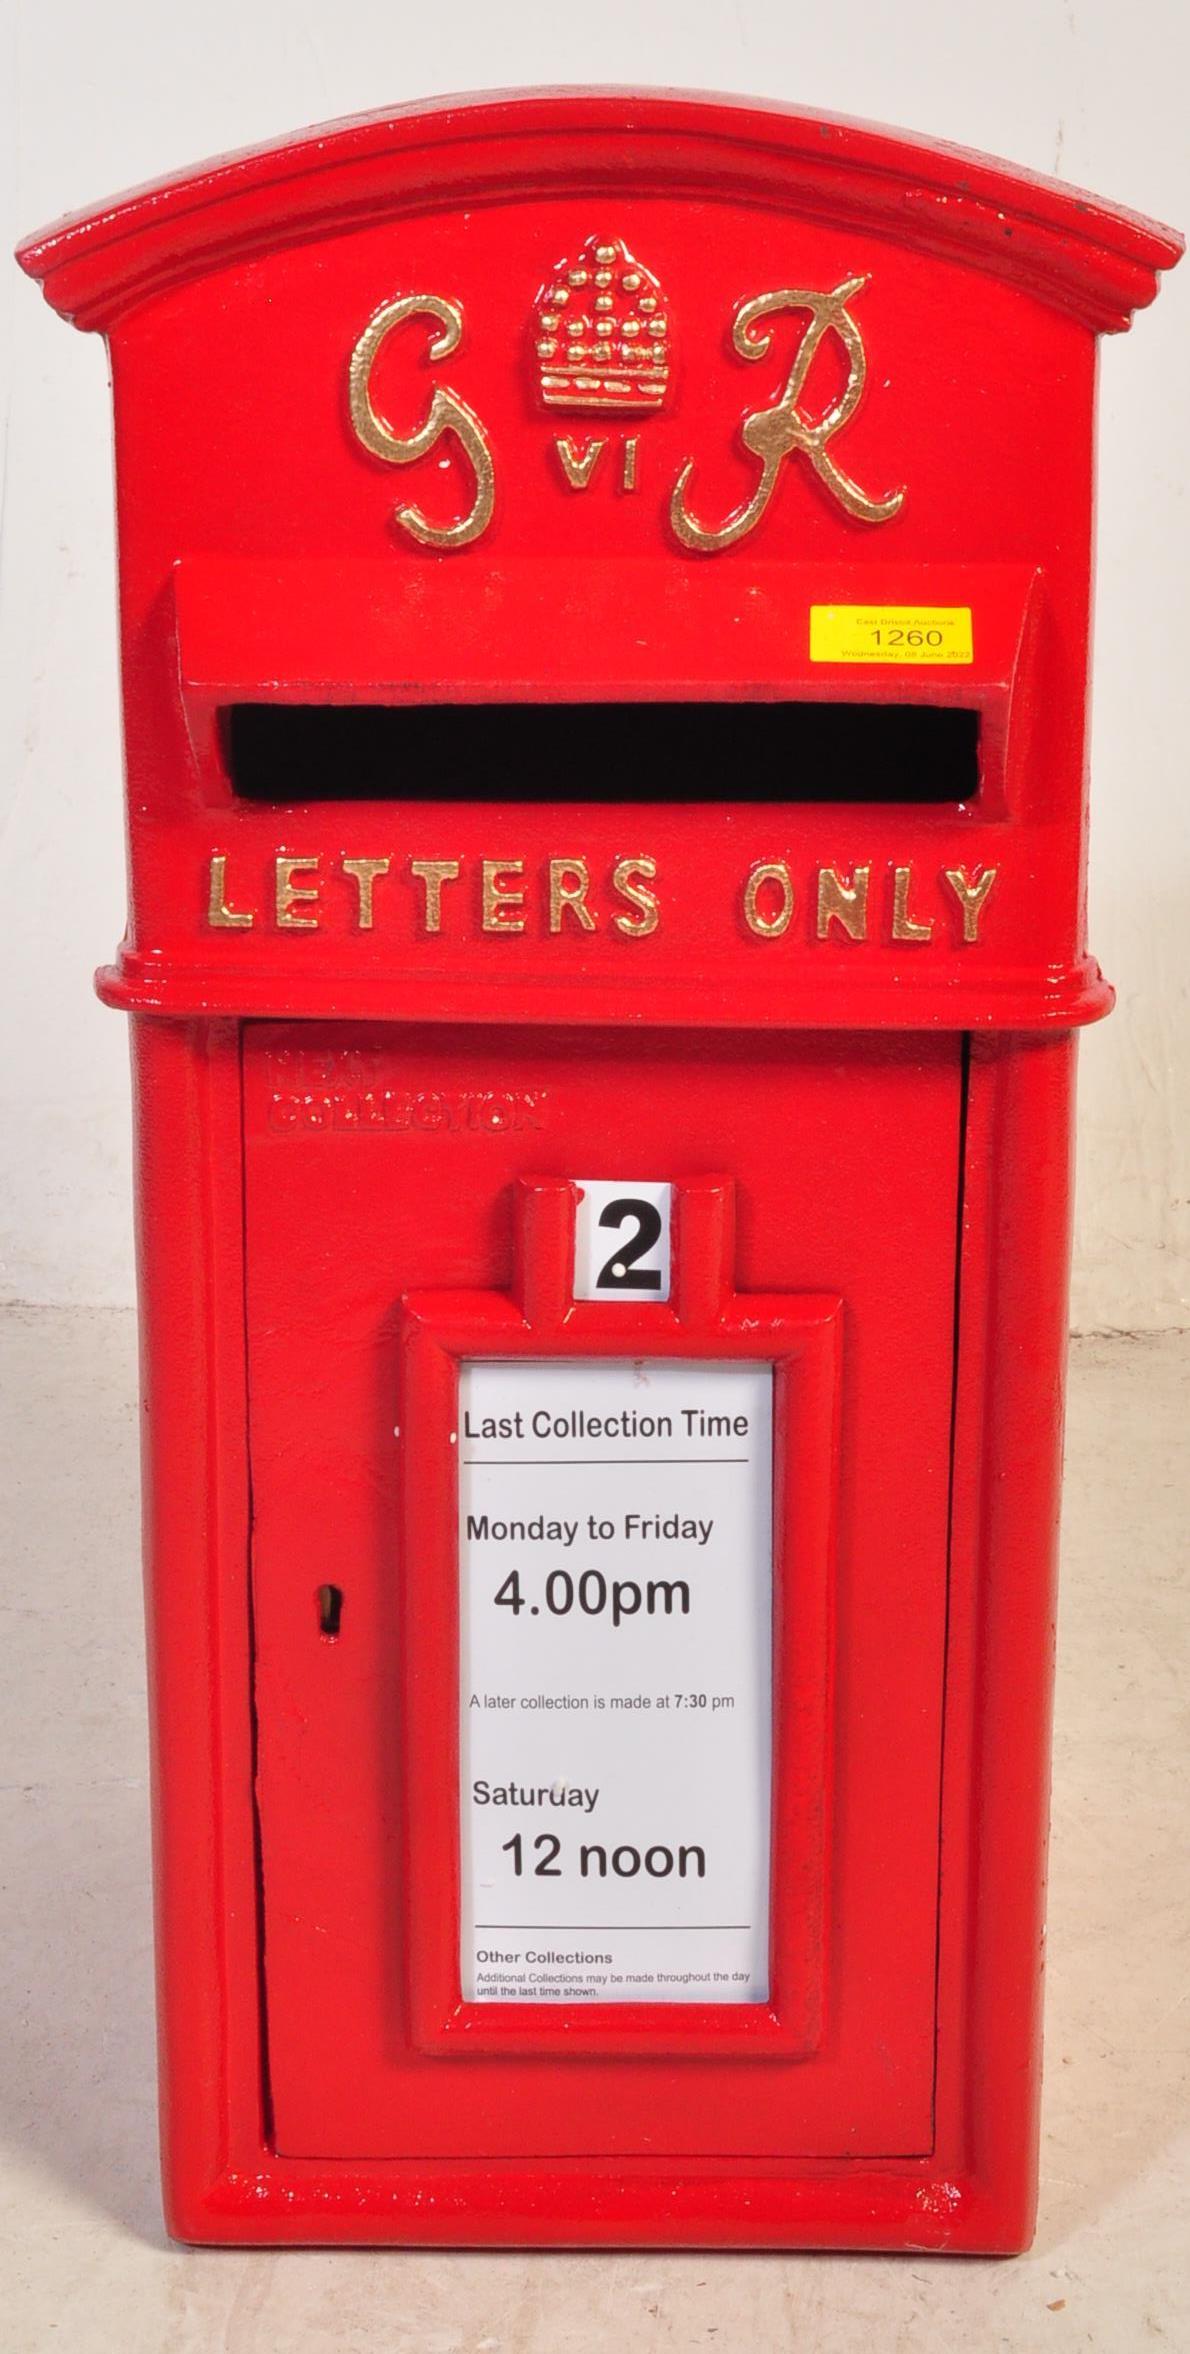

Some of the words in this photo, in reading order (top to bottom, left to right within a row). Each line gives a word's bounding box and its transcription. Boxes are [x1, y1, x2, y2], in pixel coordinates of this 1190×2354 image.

[348, 294, 495, 549] G
[670, 274, 905, 553] R
[554, 437, 638, 491] VI
[871, 629, 943, 647] 1260
[208, 855, 658, 937] LETTERS
[745, 863, 997, 941] ONLY
[596, 1198, 661, 1290] 2
[464, 1410, 524, 1438] Last
[532, 1410, 673, 1438] Collection
[681, 1409, 749, 1437] Time
[466, 1515, 578, 1546] Monday
[587, 1516, 615, 1540] to
[624, 1514, 714, 1545] Friday
[494, 1569, 690, 1627] 4.00pm
[469, 1694, 481, 1709] A
[483, 1694, 516, 1709] later
[520, 1694, 589, 1709] collection
[593, 1694, 606, 1709] is
[610, 1694, 651, 1709] made
[655, 1695, 671, 1709] at
[674, 1694, 707, 1709] 7:30
[711, 1696, 735, 1711] pm
[472, 1780, 600, 1813] Saturday
[502, 1833, 562, 1877] 12
[579, 1845, 706, 1878] noon
[476, 1950, 521, 1964] Other
[525, 1951, 613, 1965] Collections
[476, 1972, 526, 1983] Additional
[528, 1972, 583, 1984] Collections
[586, 1973, 607, 1986] may
[610, 1972, 623, 1983] be
[625, 1972, 654, 1983] made
[657, 1972, 711, 1985] throughout
[713, 1971, 729, 1982] the
[732, 1971, 750, 1983] day
[476, 1986, 498, 1996] until
[500, 1986, 517, 1996] the
[519, 1986, 537, 1996] last
[539, 1986, 561, 1997] time
[563, 1986, 599, 1997] shown.
